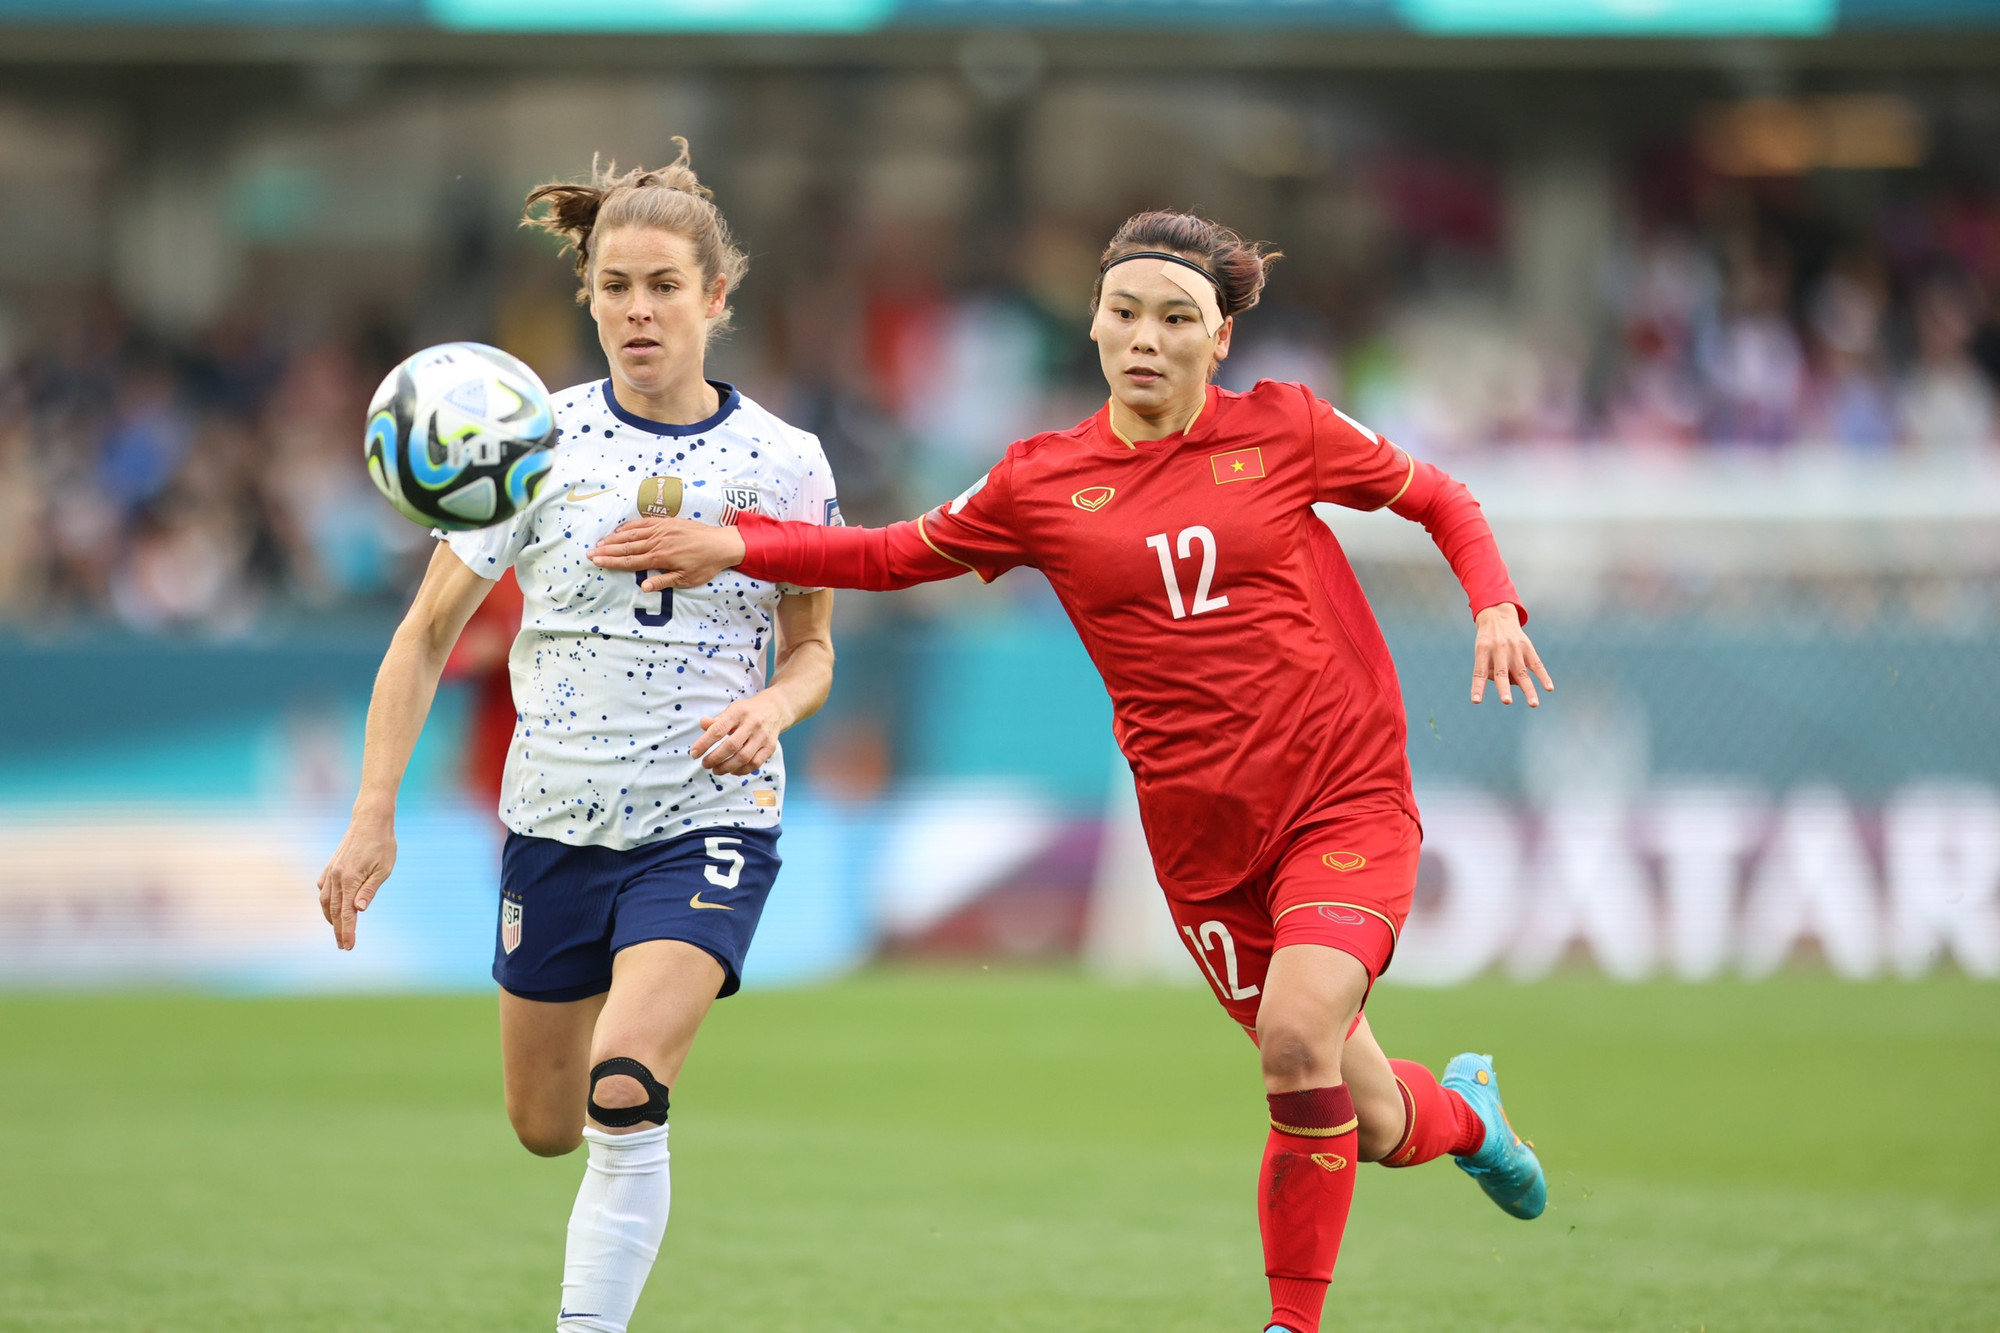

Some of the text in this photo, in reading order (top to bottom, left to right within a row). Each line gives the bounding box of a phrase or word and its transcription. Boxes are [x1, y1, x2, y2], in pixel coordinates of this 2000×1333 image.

[647, 504, 668, 515] FIFA
[725, 489, 758, 510] USA
[1145, 525, 1229, 620] 12
[703, 837, 745, 890] 5
[1182, 920, 1260, 1001] 12
